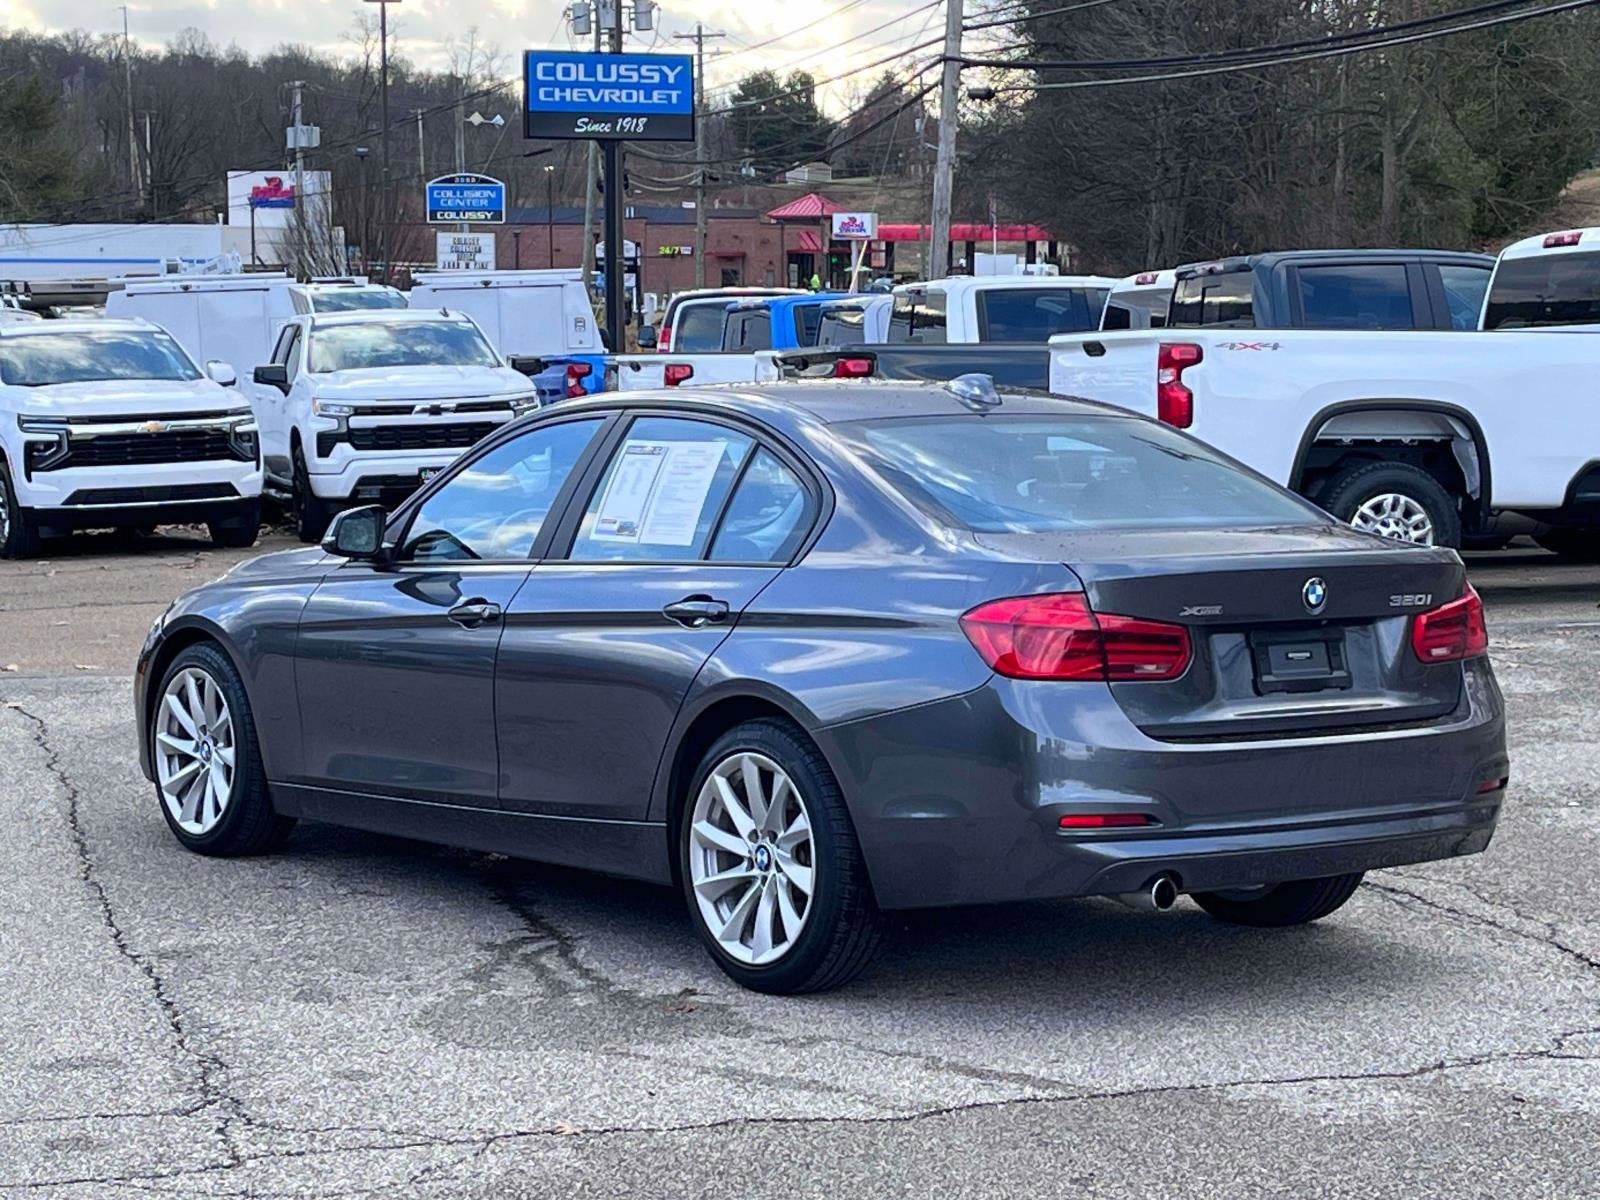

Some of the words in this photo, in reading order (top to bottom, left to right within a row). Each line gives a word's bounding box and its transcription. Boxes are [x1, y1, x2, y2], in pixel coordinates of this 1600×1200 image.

[536, 62, 683, 84] COLUSSY
[538, 87, 682, 104] CHEVROLET
[574, 117, 611, 133] Since
[616, 117, 648, 133] 1918
[433, 190, 496, 198] COLLISION
[440, 199, 489, 207] CENTER
[436, 211, 494, 220] COLUSSY
[658, 246, 680, 255] 24/7
